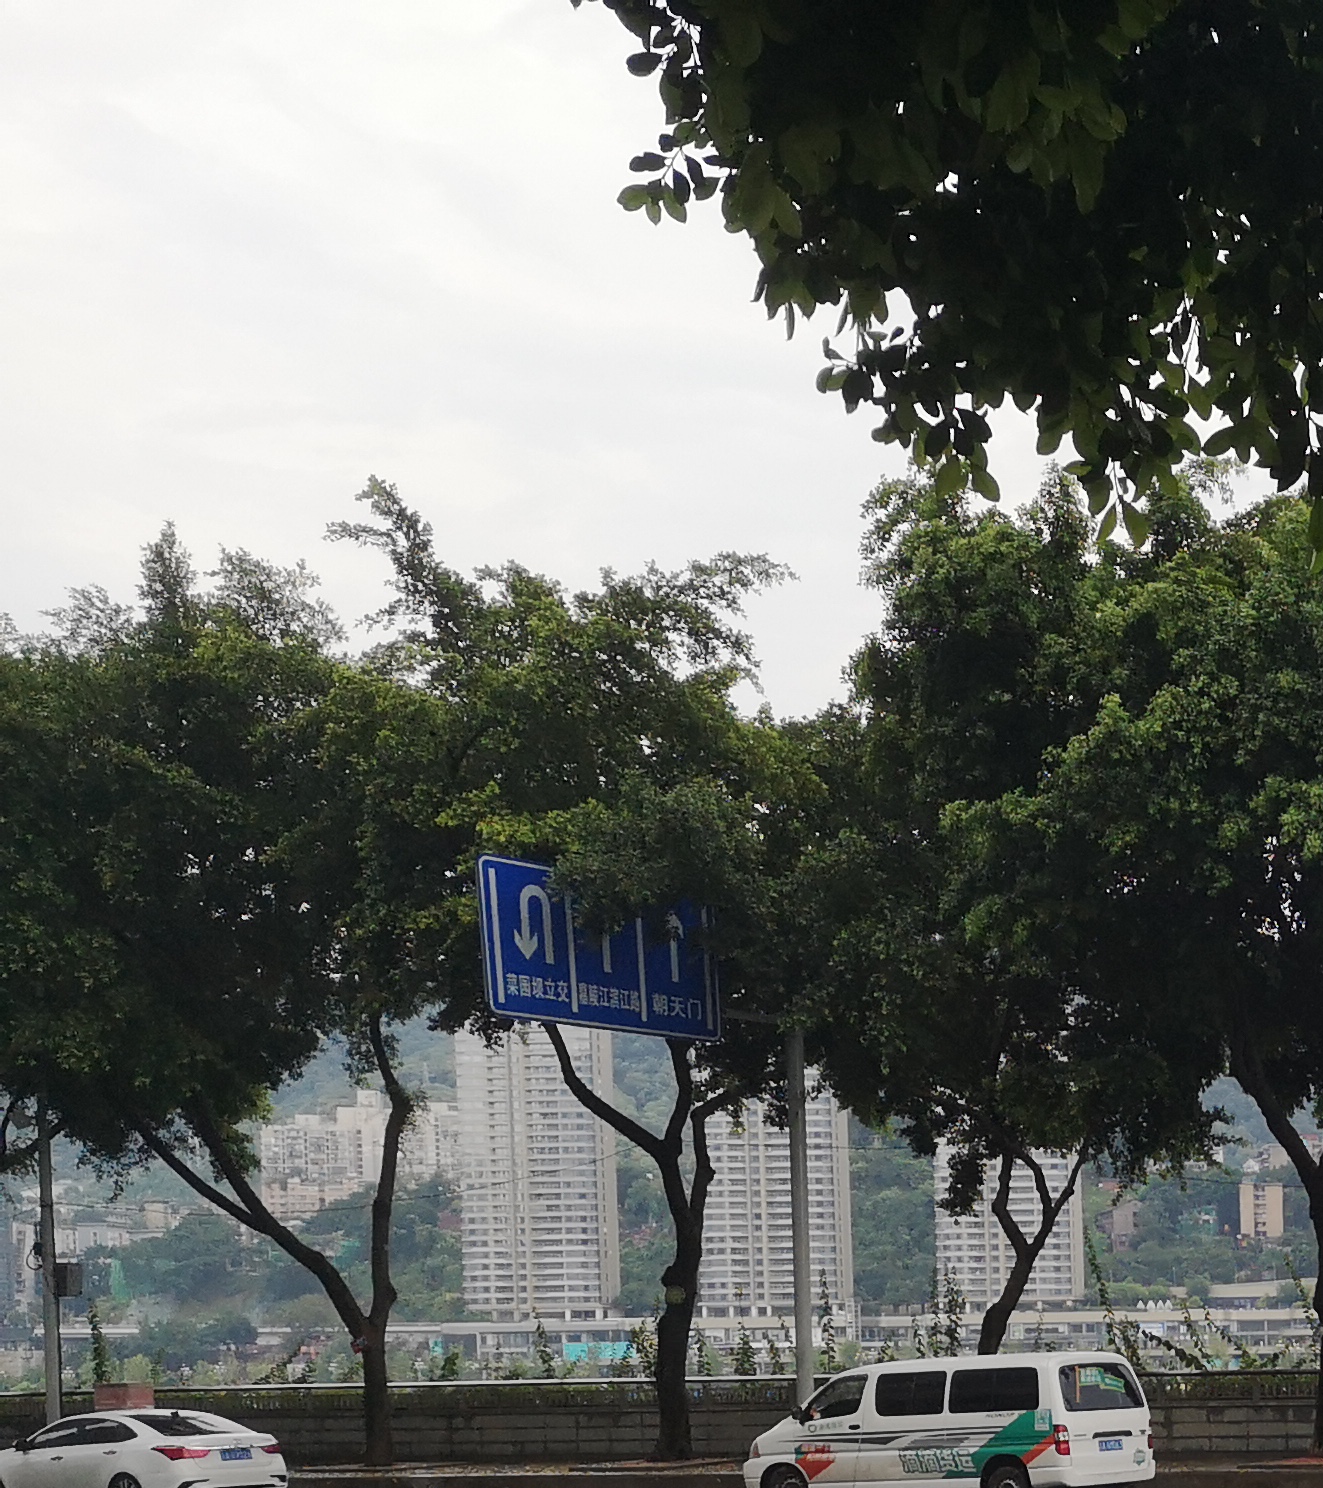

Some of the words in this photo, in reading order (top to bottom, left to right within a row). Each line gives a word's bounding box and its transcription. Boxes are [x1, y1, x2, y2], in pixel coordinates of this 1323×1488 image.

[652, 992, 702, 1020] 朝天门
[899, 1448, 977, 1474] 滴滴货运
